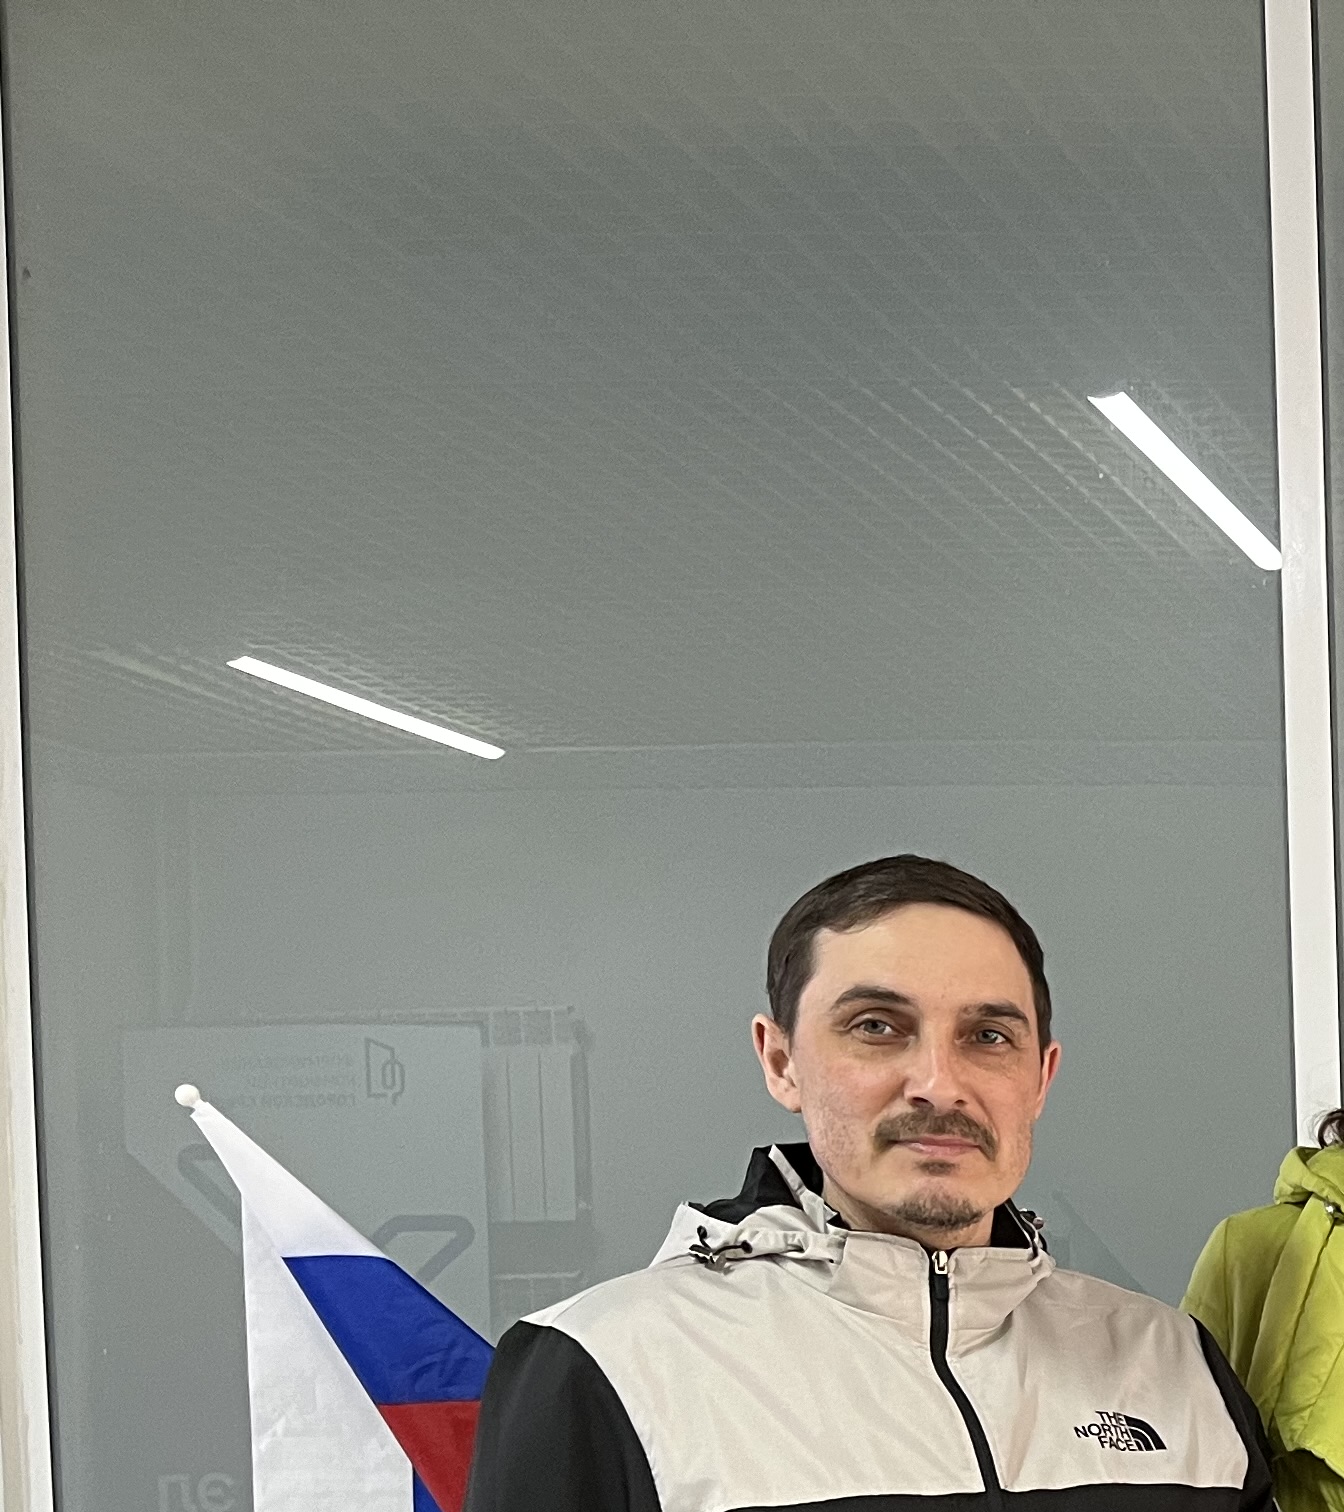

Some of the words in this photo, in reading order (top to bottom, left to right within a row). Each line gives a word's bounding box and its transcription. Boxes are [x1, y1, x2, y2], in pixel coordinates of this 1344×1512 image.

[1095, 1410, 1126, 1426] THE
[1074, 1423, 1132, 1440] NORTH
[1098, 1436, 1138, 1451] FACE
